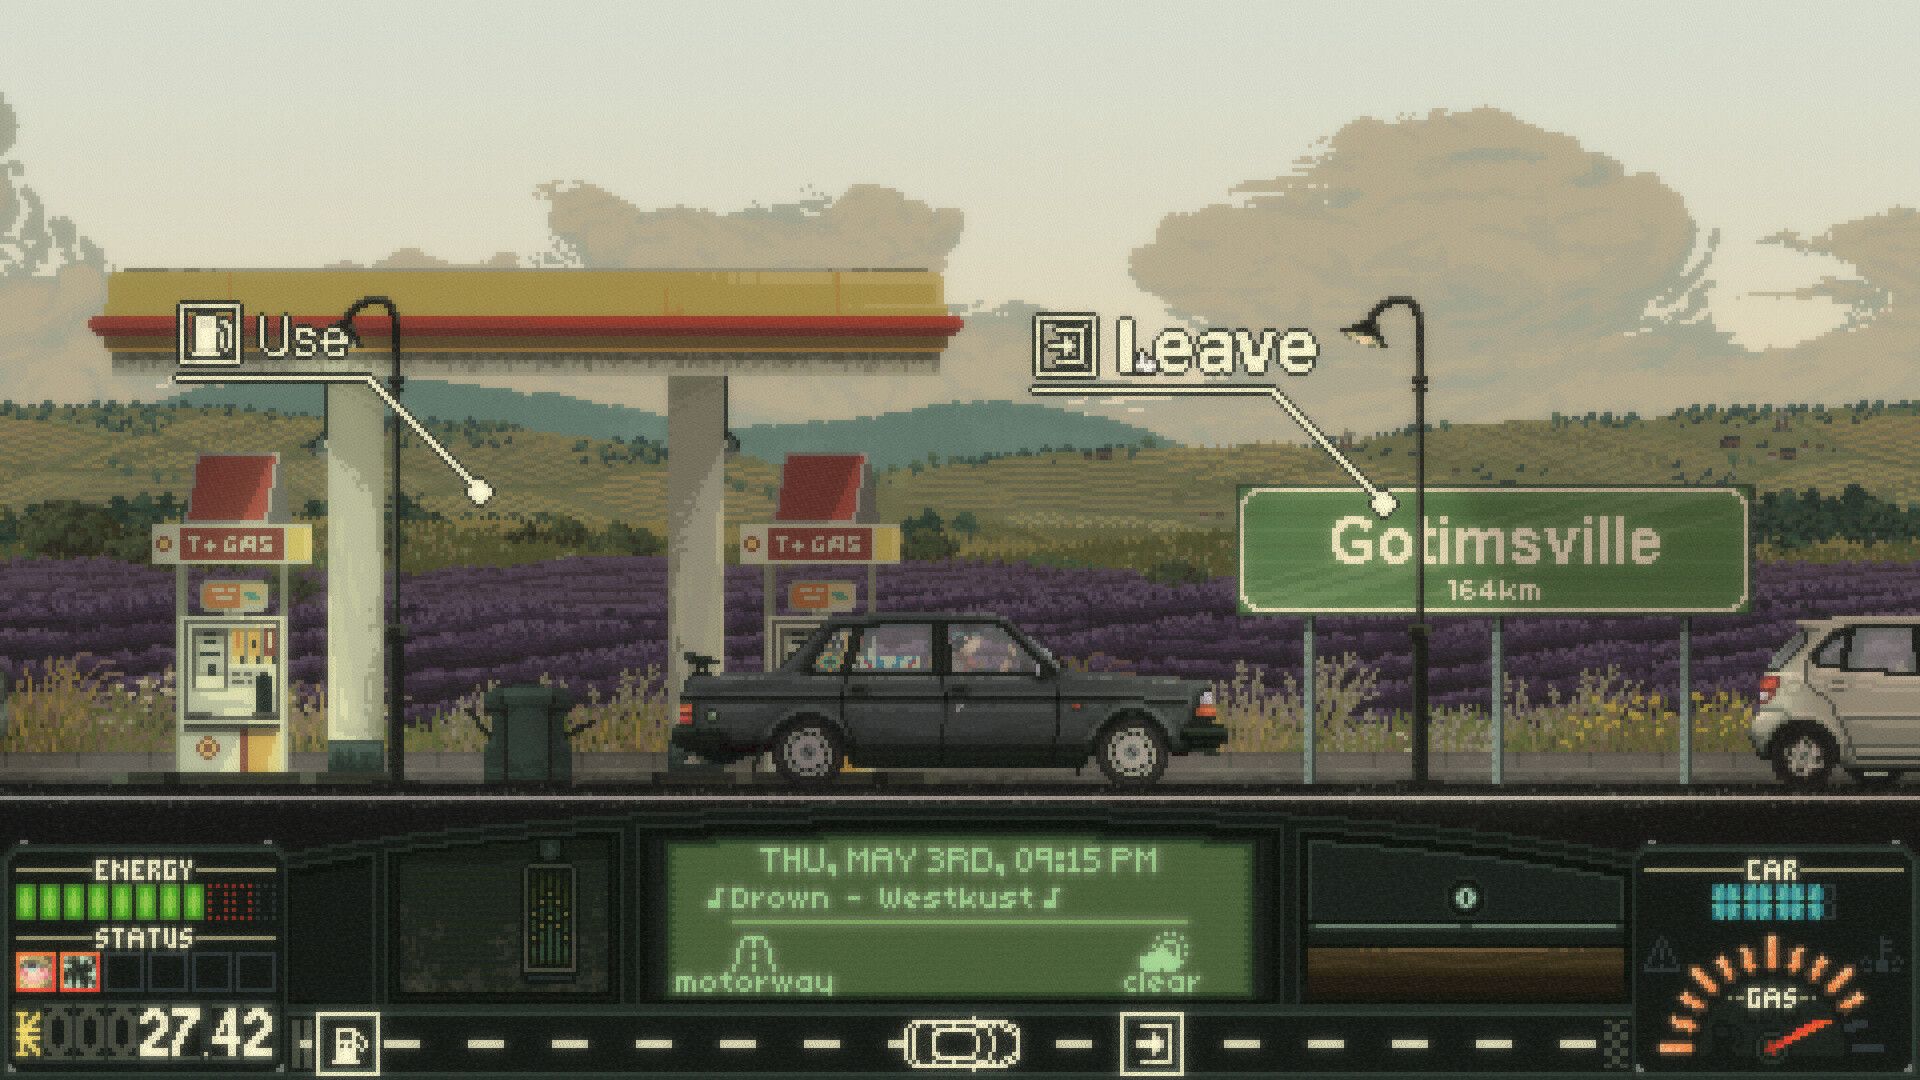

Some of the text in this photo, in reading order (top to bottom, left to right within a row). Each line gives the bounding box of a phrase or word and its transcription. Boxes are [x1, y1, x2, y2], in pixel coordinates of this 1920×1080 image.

[1330, 514, 1662, 566] Gotimsville
[1447, 578, 1542, 602] 164km
[95, 859, 193, 881] ENERGY
[760, 847, 1158, 877] THU, MAY 3RD, 09:15 PM
[1747, 859, 1797, 881] CAR
[731, 887, 829, 909] Drown
[880, 887, 1032, 909] Westkust
[95, 927, 193, 949] STATUS
[675, 972, 833, 996] motorway
[1122, 972, 1200, 994] clear
[1747, 987, 1797, 1009] GAS
